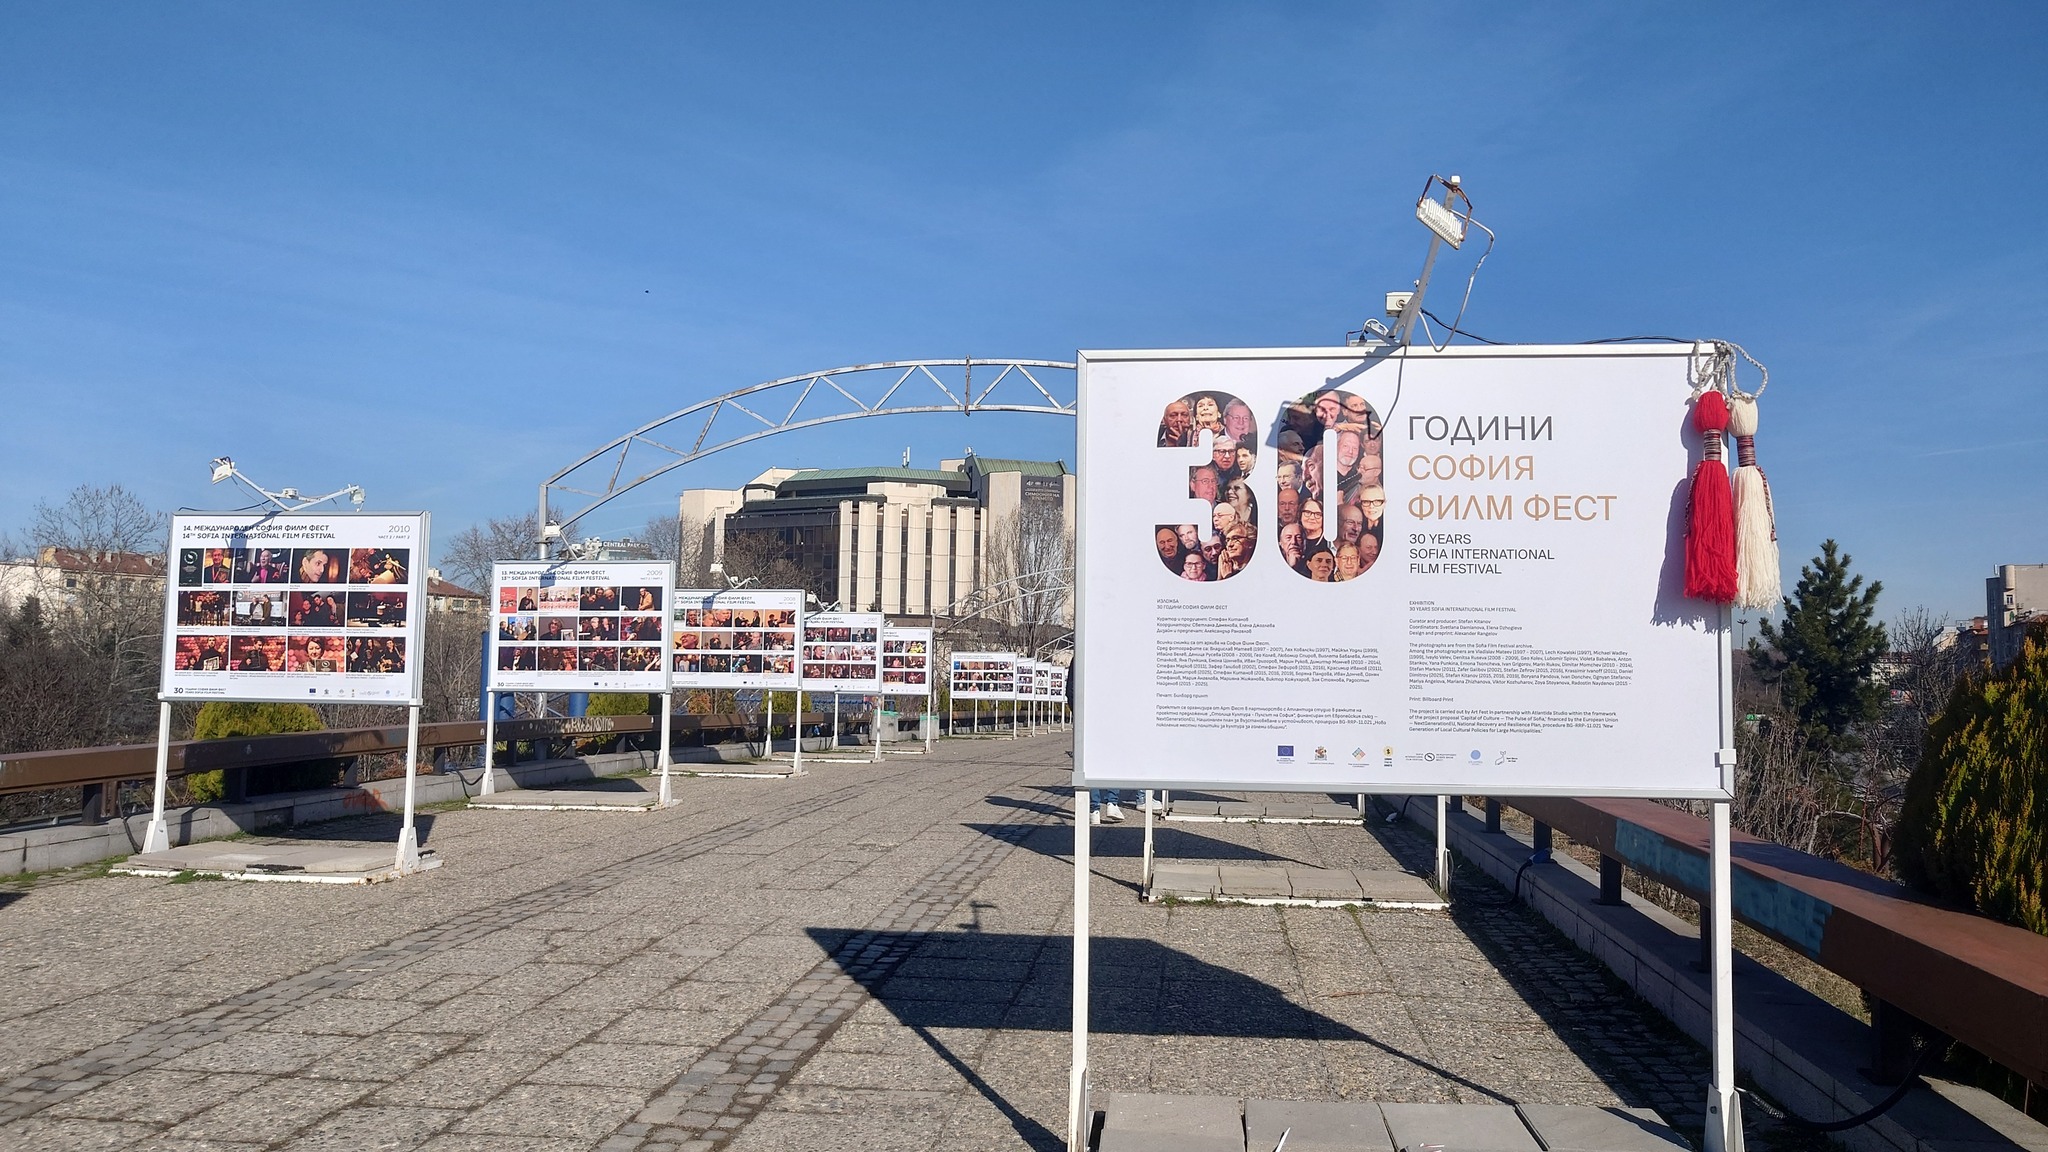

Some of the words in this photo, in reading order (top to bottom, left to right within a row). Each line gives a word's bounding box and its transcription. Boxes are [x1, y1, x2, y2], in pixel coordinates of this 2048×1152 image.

[1408, 415, 1554, 445] ГОДИНИ
[1408, 454, 1534, 481] СОФИЯ
[1155, 390, 1385, 583] 30
[1408, 493, 1513, 521] ФИЛМ
[1523, 493, 1618, 522] ФЕСТ
[388, 524, 411, 533] 2010
[1408, 533, 1428, 545] 30
[1429, 533, 1472, 545] YEARS
[1408, 548, 1449, 560] SOFIA
[1451, 548, 1555, 561] INTERNATIONAL
[1409, 563, 1440, 574] FILM
[1442, 563, 1503, 575] FESTIVAL
